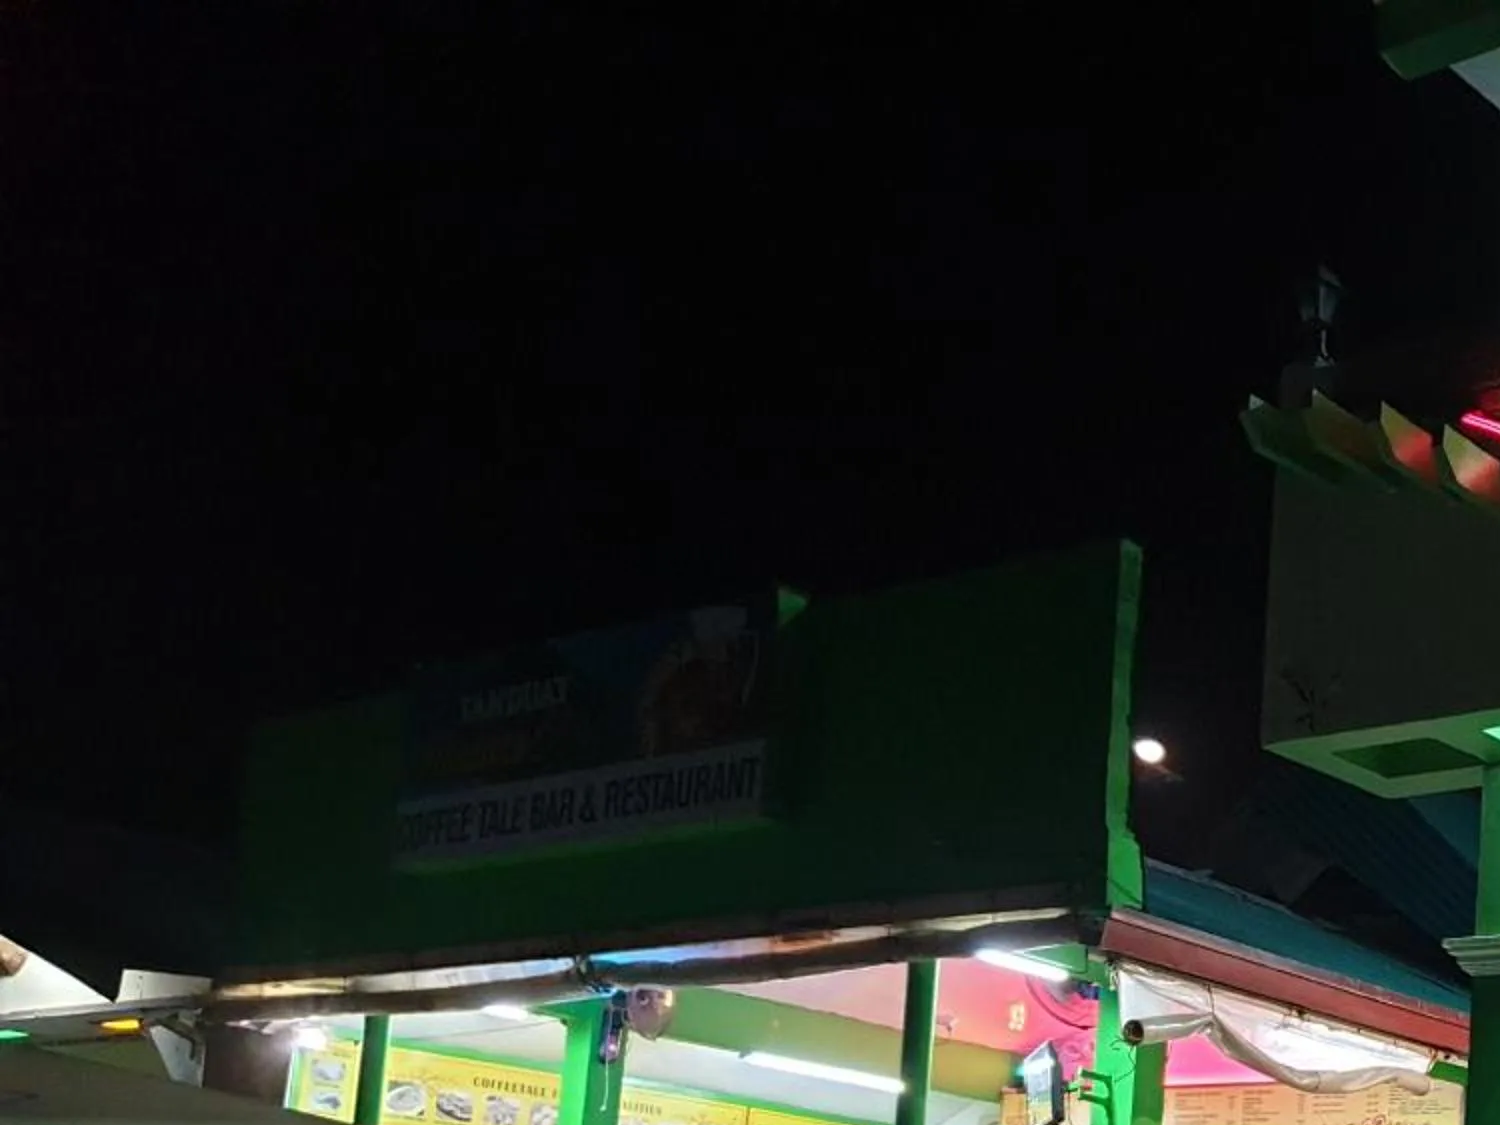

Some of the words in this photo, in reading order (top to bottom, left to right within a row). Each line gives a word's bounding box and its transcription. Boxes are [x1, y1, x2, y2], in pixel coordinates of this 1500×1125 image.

[399, 802, 473, 852] COFFEE
[478, 797, 522, 840] TALE
[531, 788, 574, 830] BAR
[580, 782, 598, 823] &
[605, 758, 761, 817] RESTAURANT
